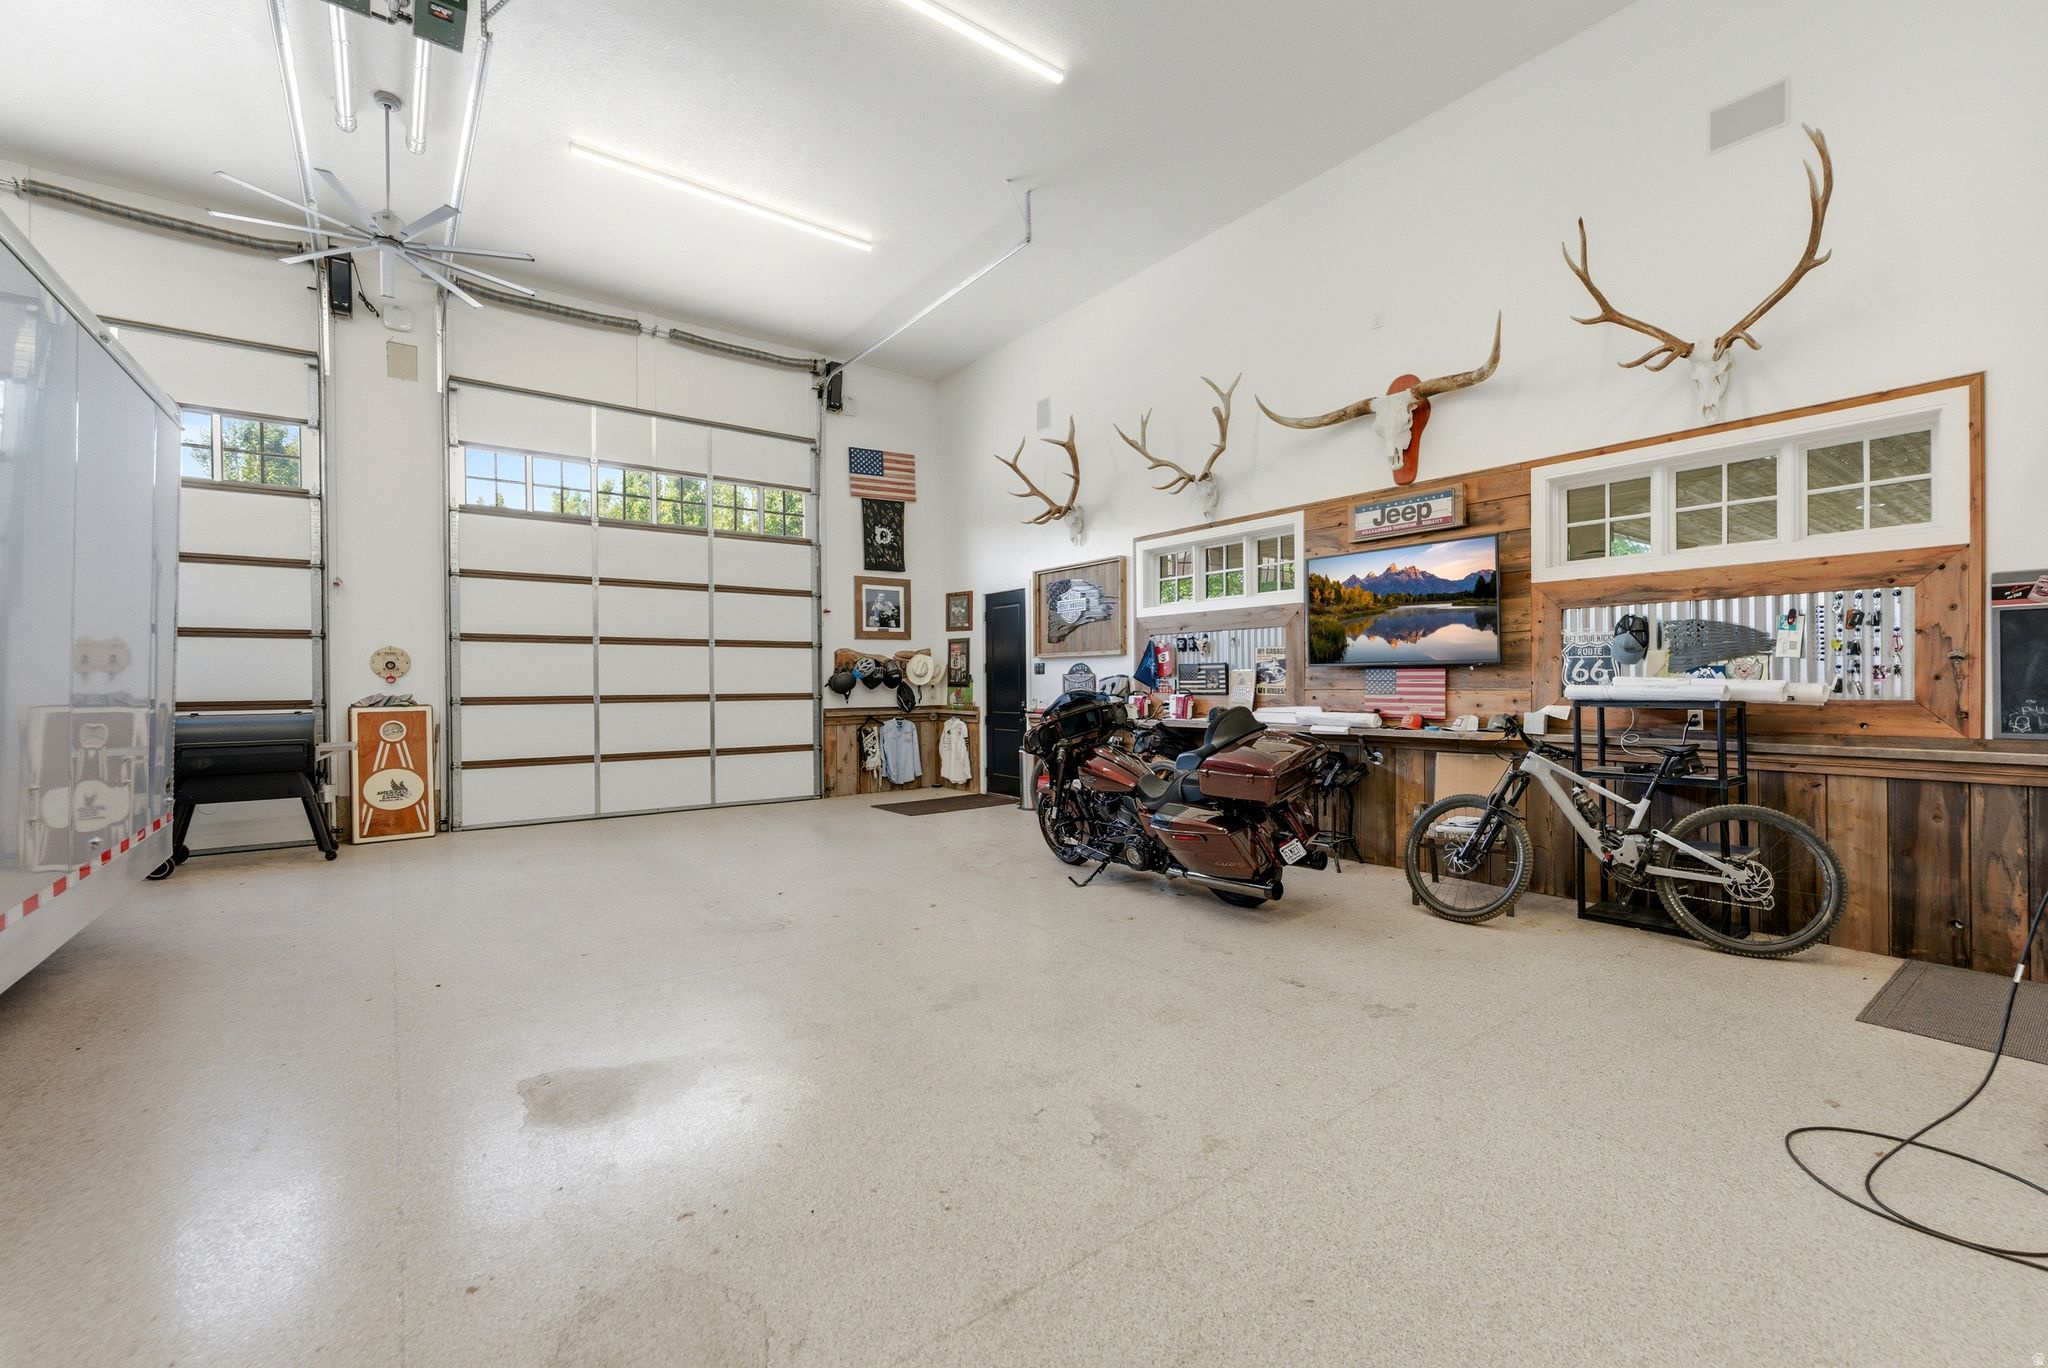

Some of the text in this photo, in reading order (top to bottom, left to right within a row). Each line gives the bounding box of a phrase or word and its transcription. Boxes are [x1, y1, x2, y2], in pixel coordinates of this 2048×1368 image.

[1372, 502, 1432, 527] Jeep
[1578, 634, 1595, 643] YOUR
[1577, 646, 1603, 656] ROUTE
[1571, 659, 1608, 682] 66
